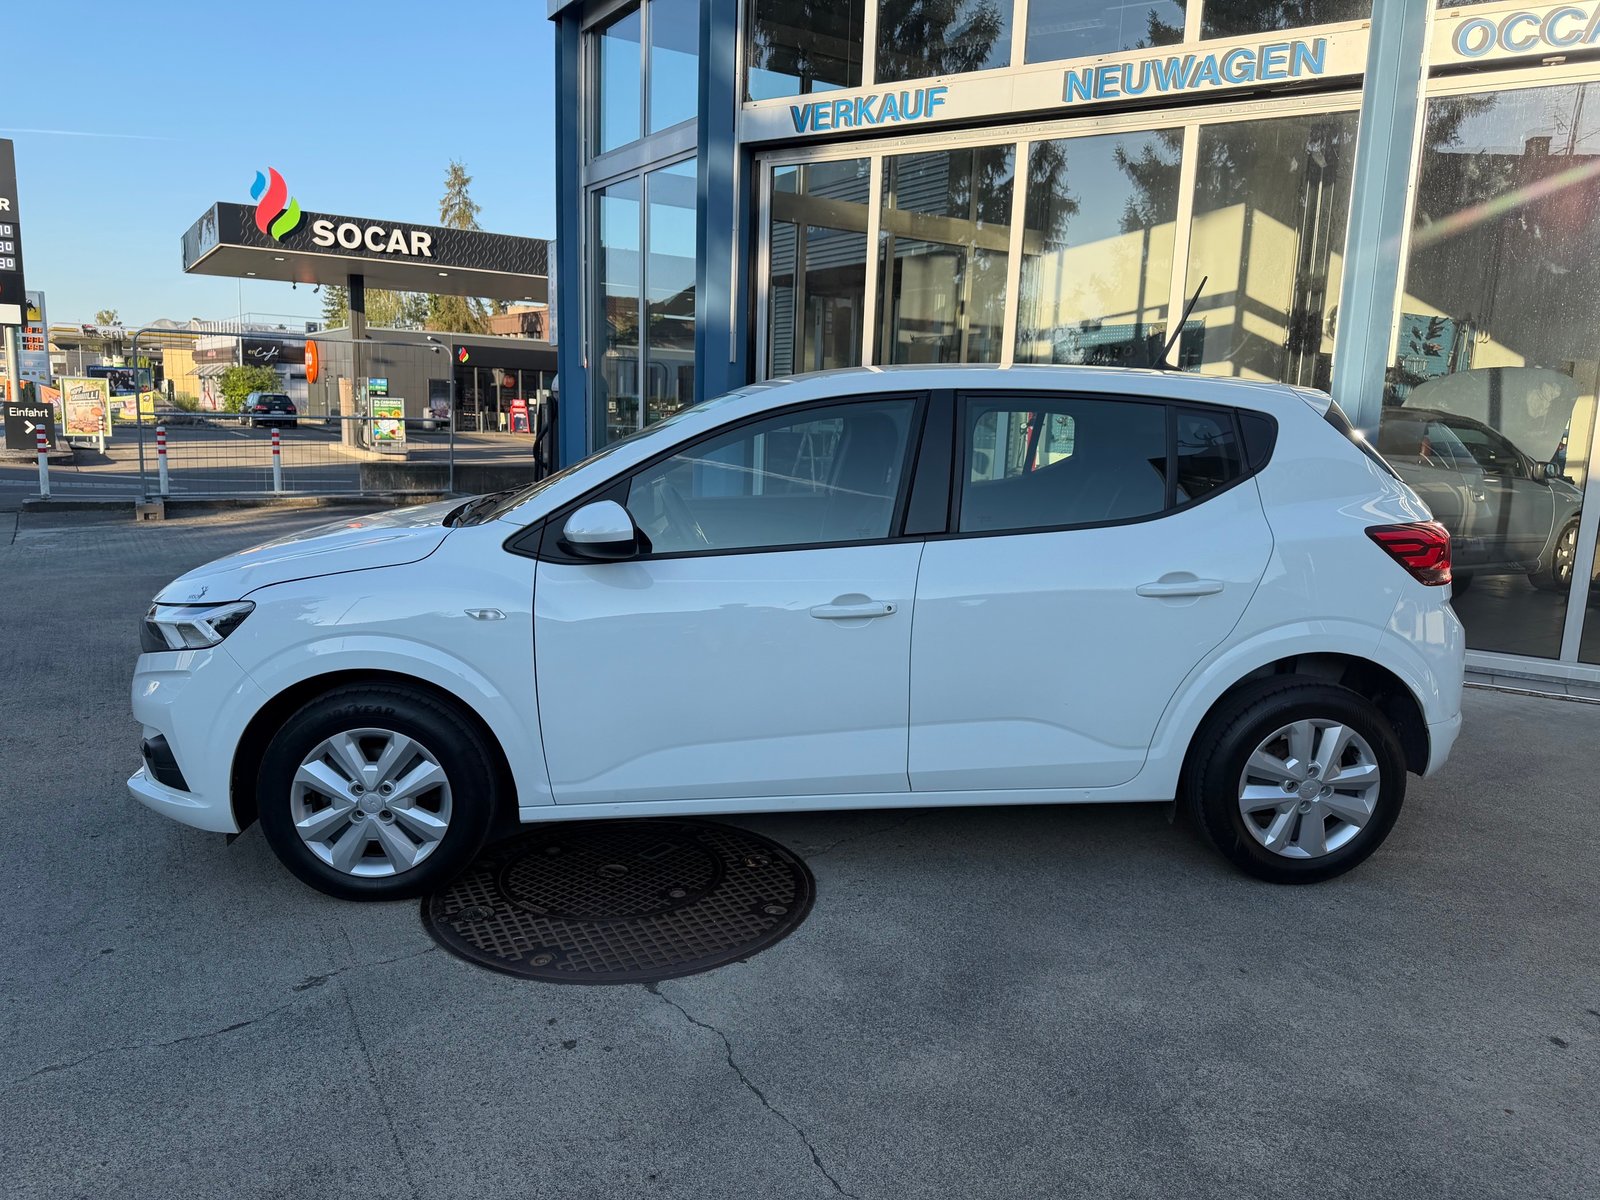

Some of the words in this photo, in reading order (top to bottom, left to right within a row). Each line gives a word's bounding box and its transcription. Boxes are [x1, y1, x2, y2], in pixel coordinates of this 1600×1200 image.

[1062, 38, 1327, 102] NEUWAGEN
[789, 86, 948, 133] VERKAUF
[312, 220, 433, 257] SOCAR
[9, 407, 49, 418] Einfahrt
